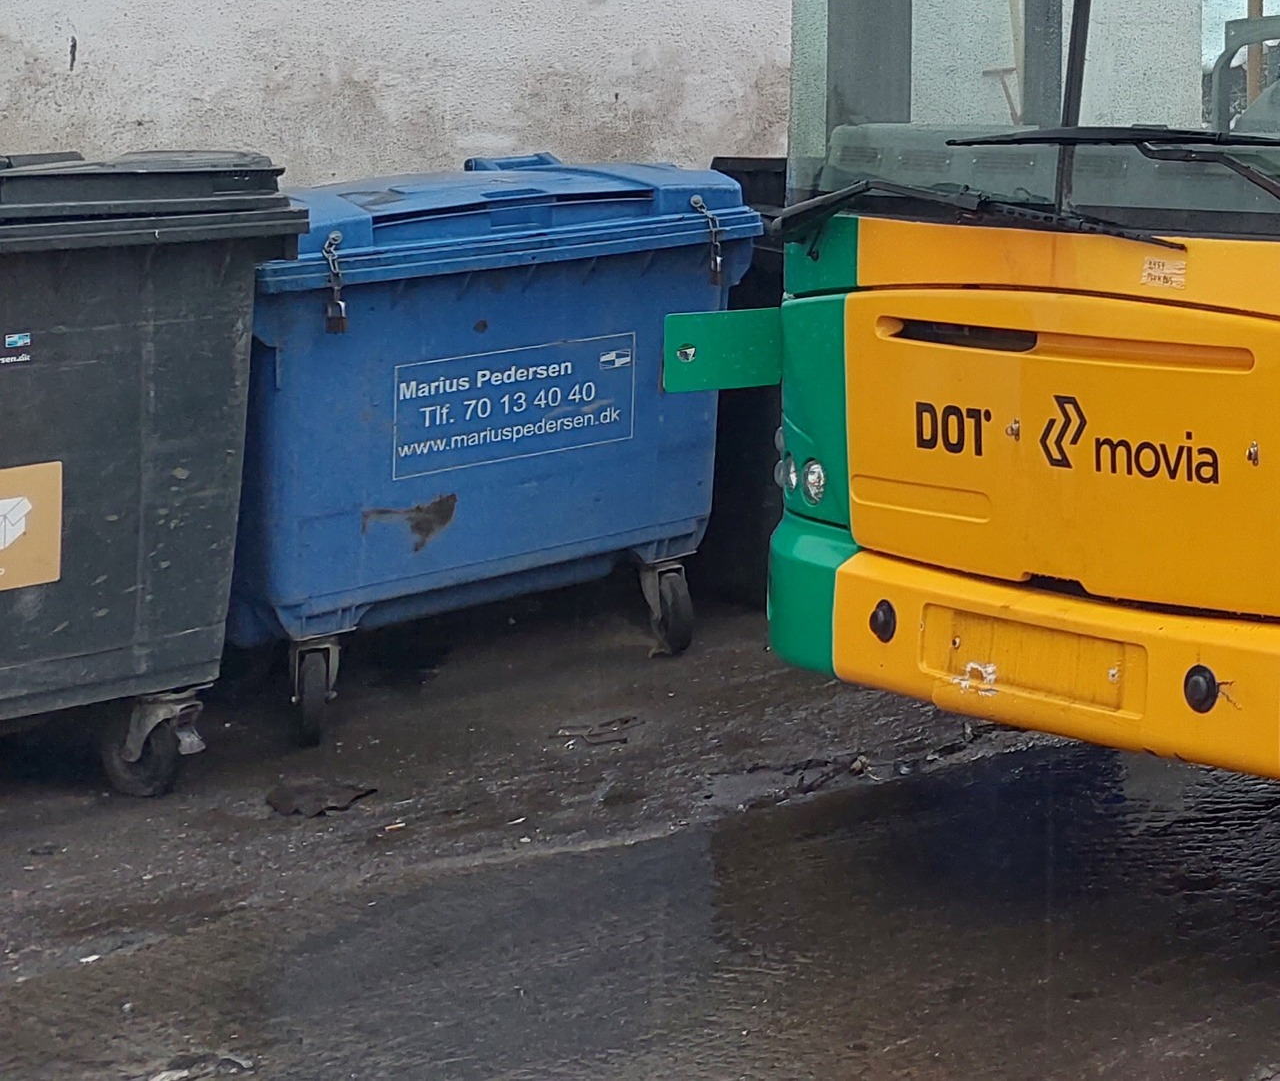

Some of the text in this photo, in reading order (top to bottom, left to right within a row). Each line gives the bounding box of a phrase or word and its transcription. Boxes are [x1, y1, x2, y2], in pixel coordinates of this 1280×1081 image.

[399, 361, 572, 400] Marius Pedersen
[420, 382, 595, 428] Tlf. 70 13 40 40
[398, 406, 621, 457] www.mariuspedersen.dk
[916, 401, 992, 456] DOT
[1094, 431, 1219, 484] movia
